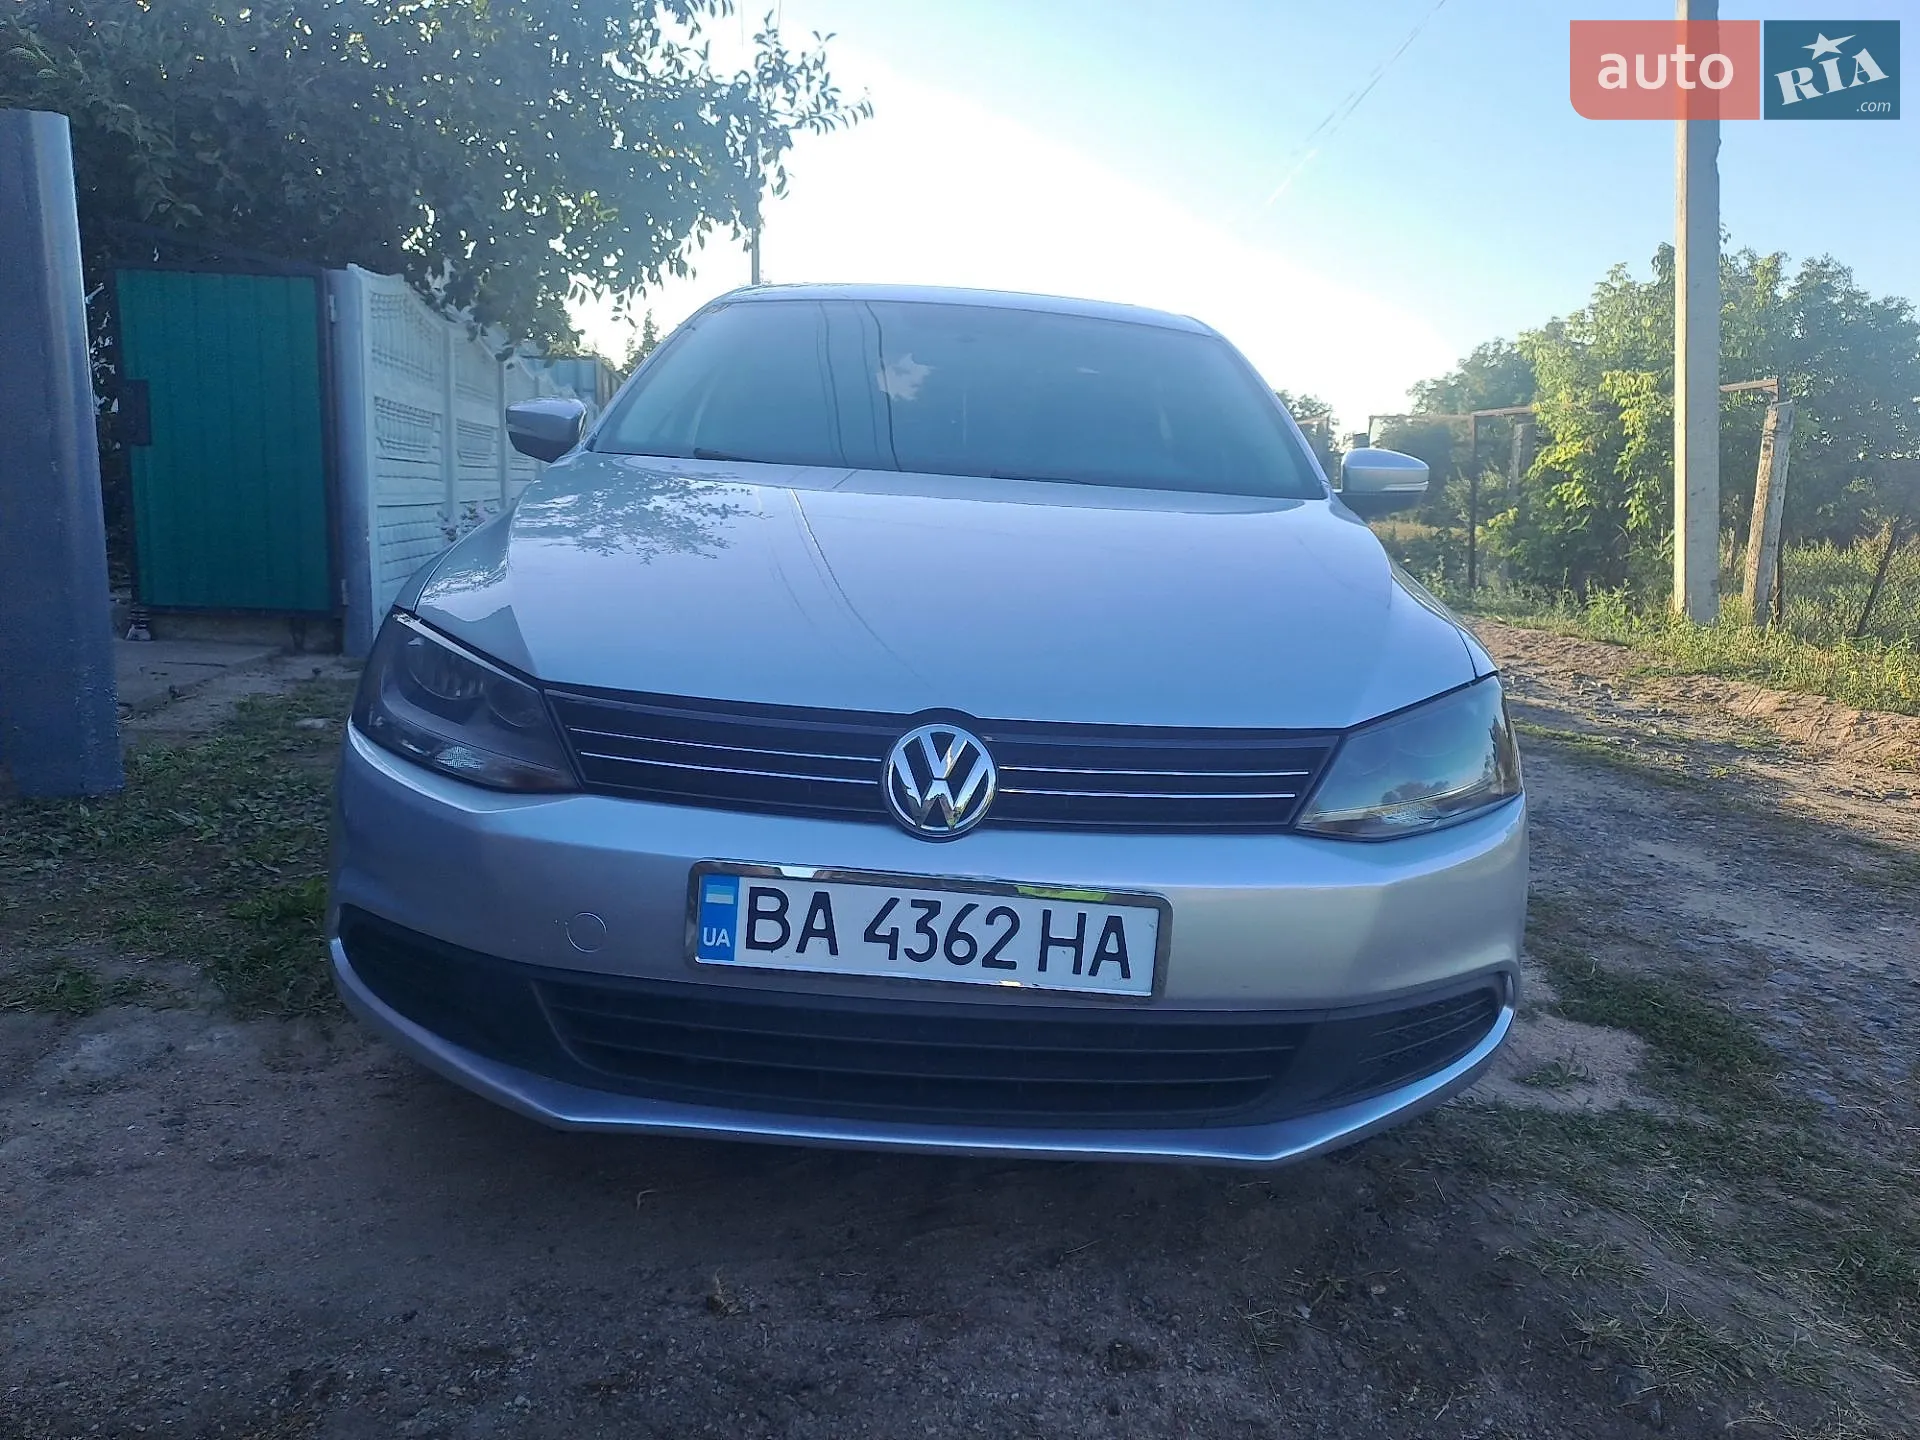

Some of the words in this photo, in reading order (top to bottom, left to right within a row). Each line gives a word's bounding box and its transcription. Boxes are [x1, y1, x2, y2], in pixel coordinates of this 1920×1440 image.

[702, 926, 731, 948] UA
[745, 885, 839, 956] BA
[862, 896, 1021, 971] 4362
[1037, 908, 1132, 980] HA
